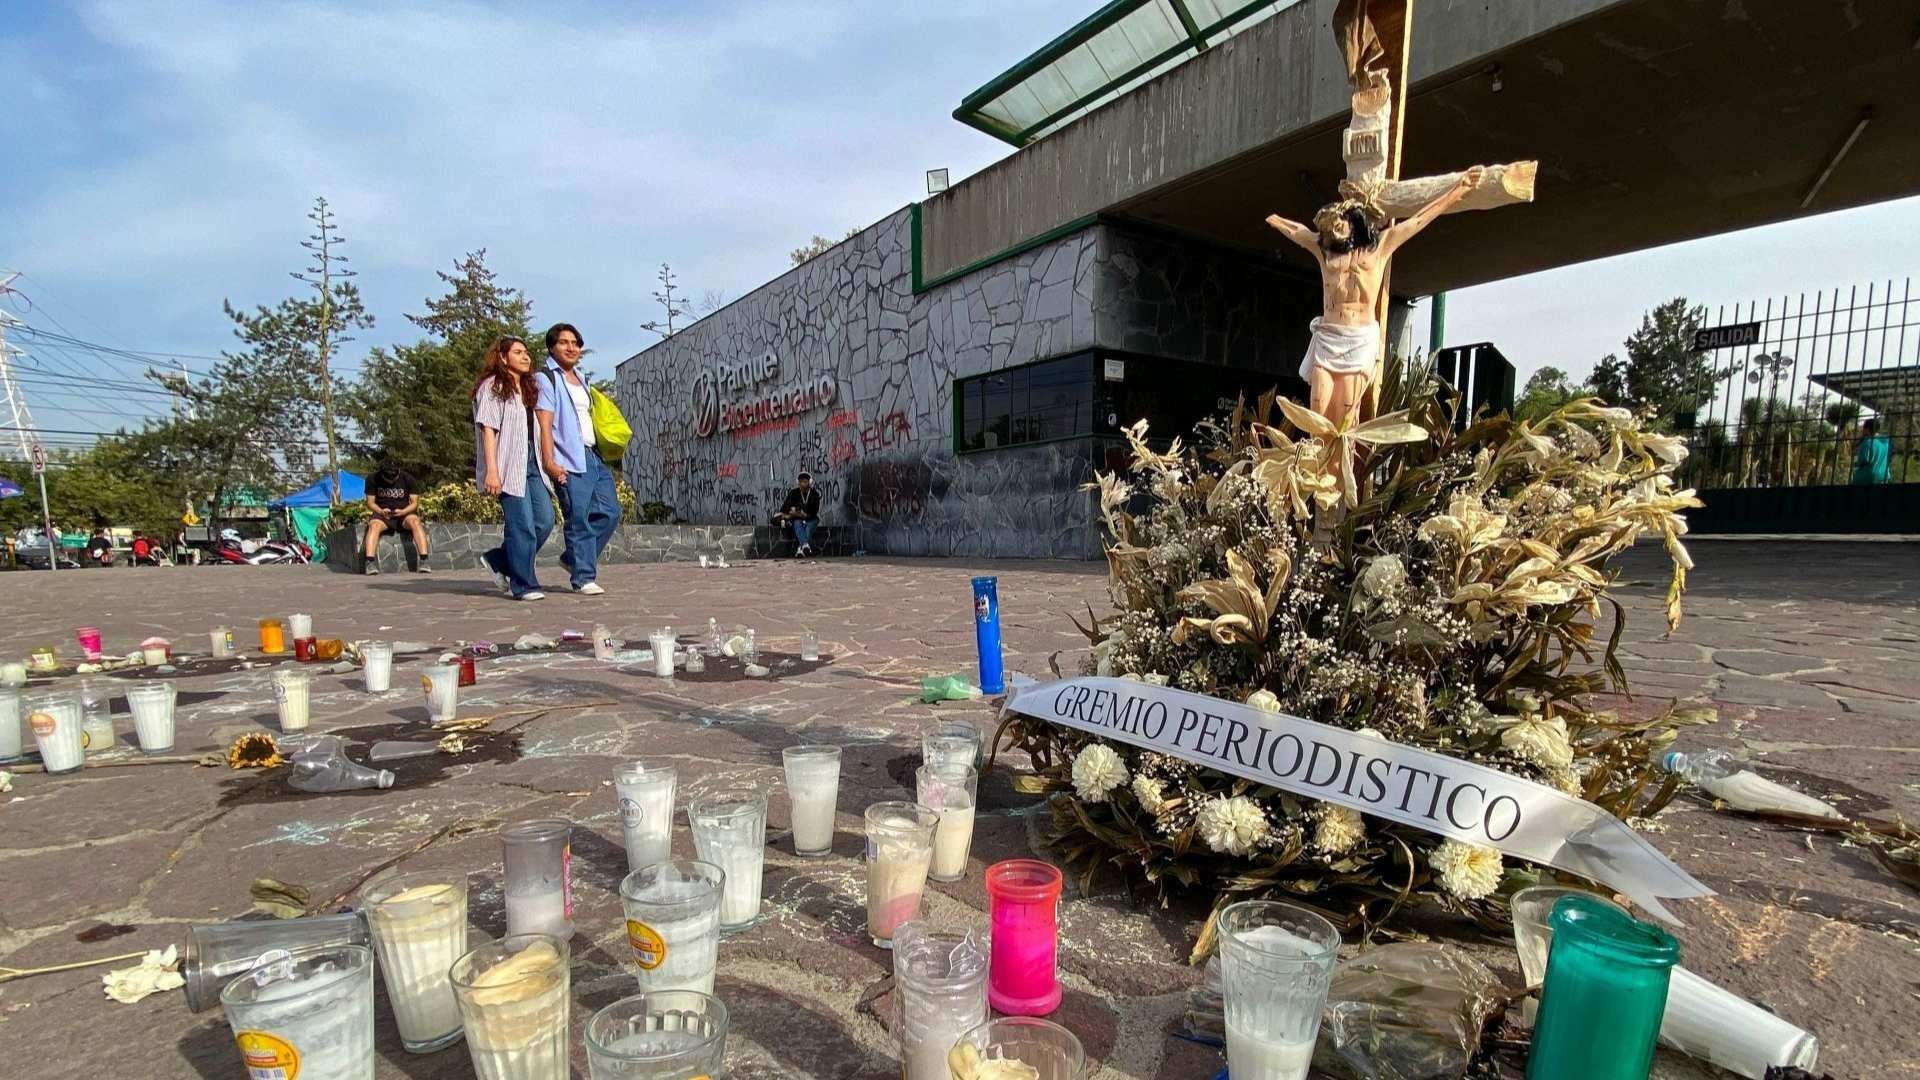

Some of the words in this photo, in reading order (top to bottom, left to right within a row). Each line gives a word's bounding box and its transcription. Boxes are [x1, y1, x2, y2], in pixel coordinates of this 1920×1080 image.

[1699, 327, 1754, 347] SALIDA
[717, 352, 778, 392] Parque
[719, 374, 836, 433] Bicentenario
[799, 430, 821, 451] LUIS
[1053, 684, 1168, 740] GREMIO
[1171, 707, 1522, 842] PERIODISTICO
